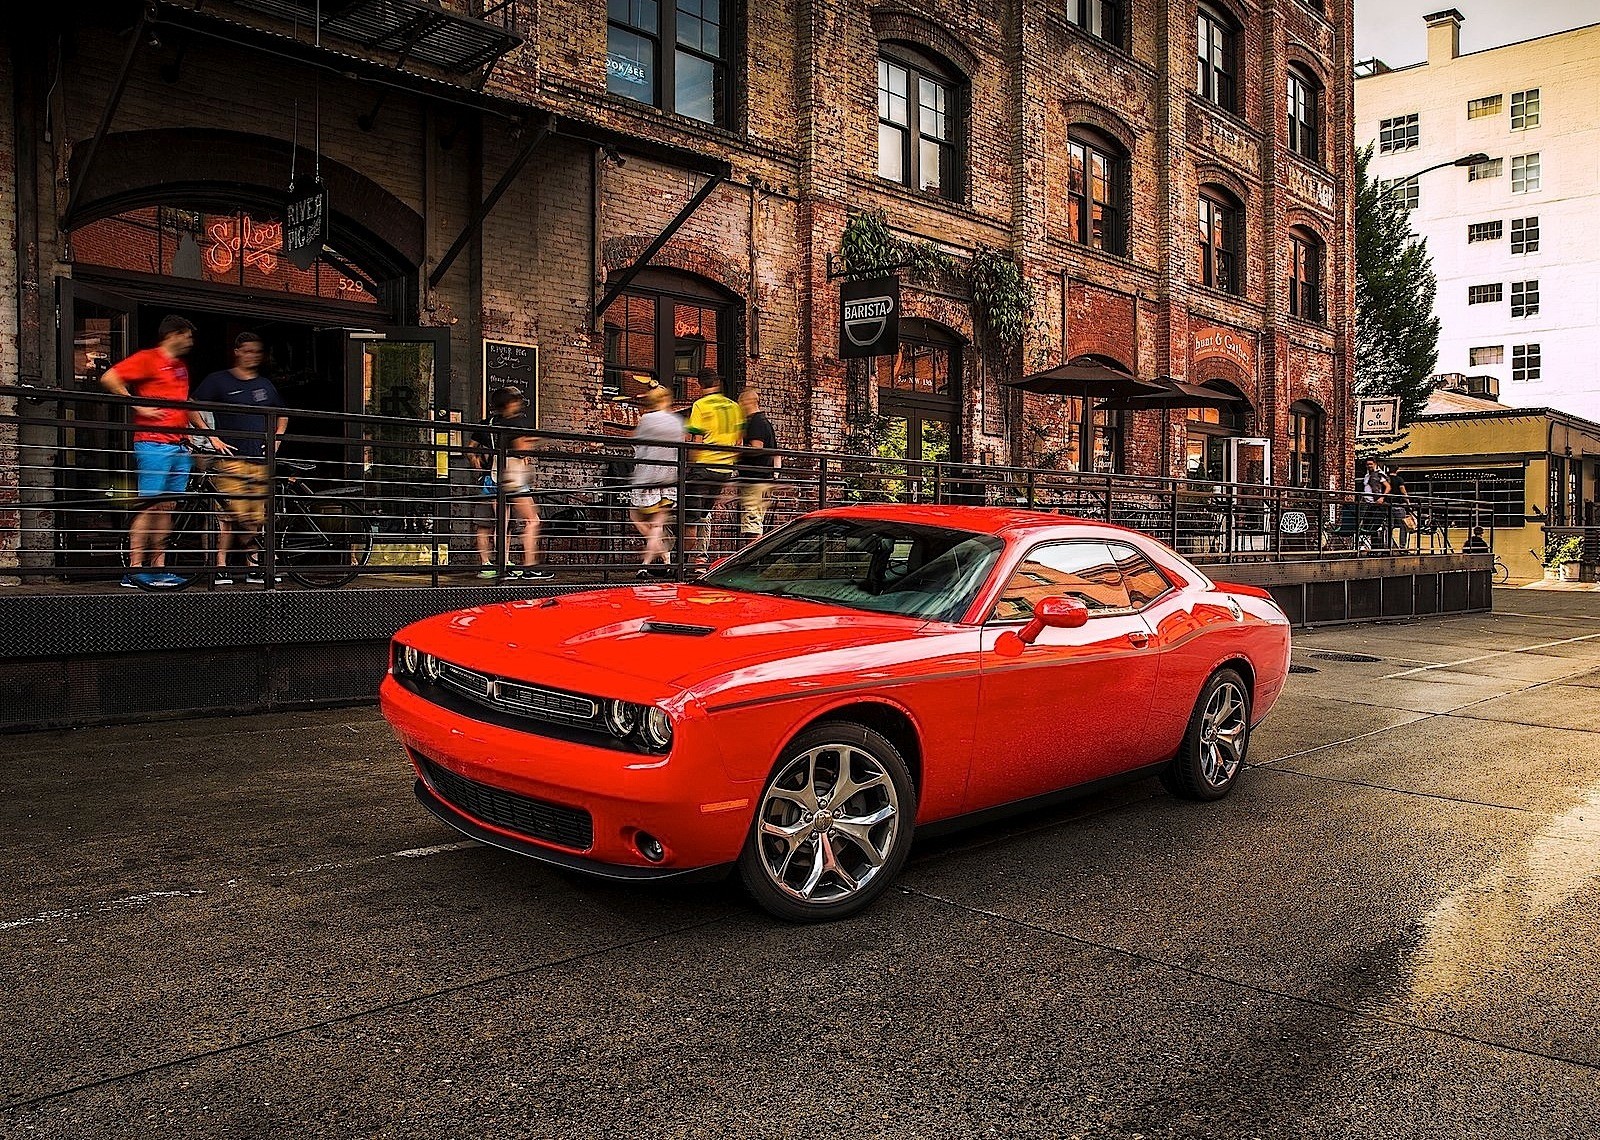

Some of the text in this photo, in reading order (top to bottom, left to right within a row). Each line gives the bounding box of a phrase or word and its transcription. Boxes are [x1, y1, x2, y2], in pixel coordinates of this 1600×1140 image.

[288, 193, 322, 227] RIVER
[288, 225, 306, 251] PIG
[338, 278, 363, 292] 529
[844, 302, 887, 320] BARISTA
[1215, 332, 1223, 346] &
[490, 345, 512, 356] RIVER
